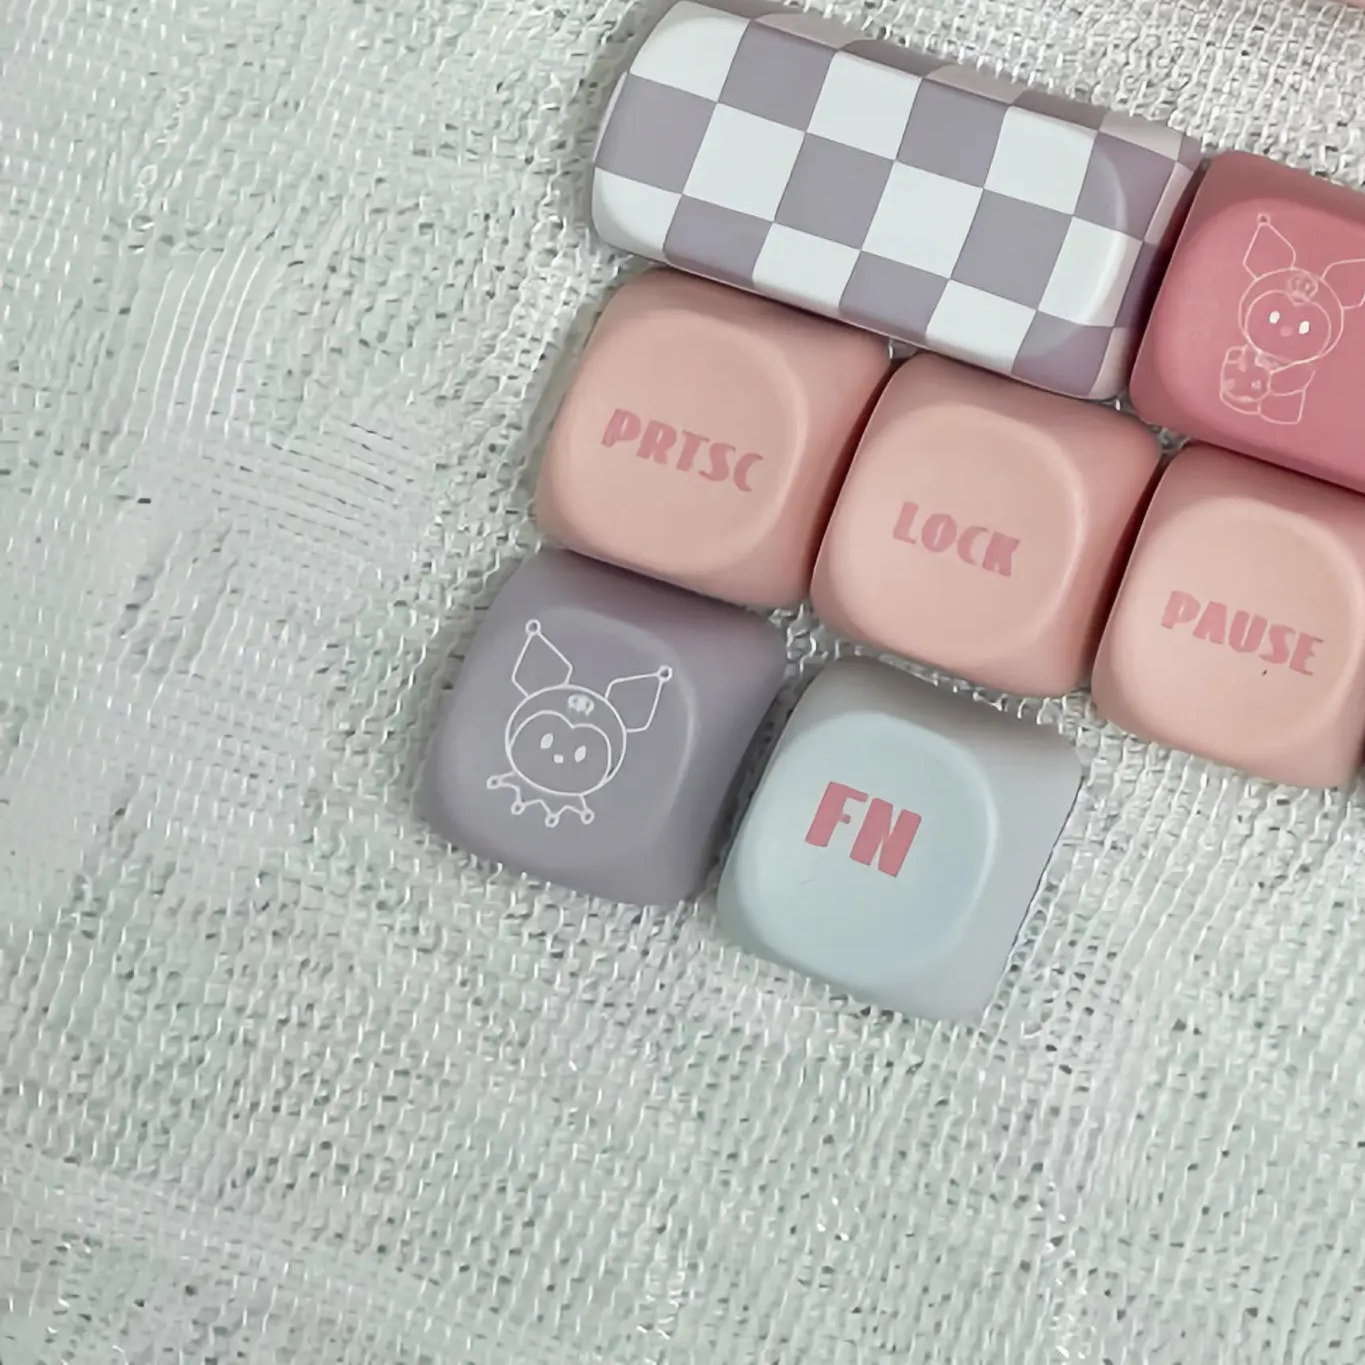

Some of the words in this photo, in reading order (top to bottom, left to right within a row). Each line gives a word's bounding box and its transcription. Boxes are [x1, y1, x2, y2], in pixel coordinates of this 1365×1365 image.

[601, 408, 764, 493] PRTSC
[893, 502, 1021, 578] LOCK
[1159, 589, 1326, 679] PAUSE
[803, 778, 923, 878] FN
